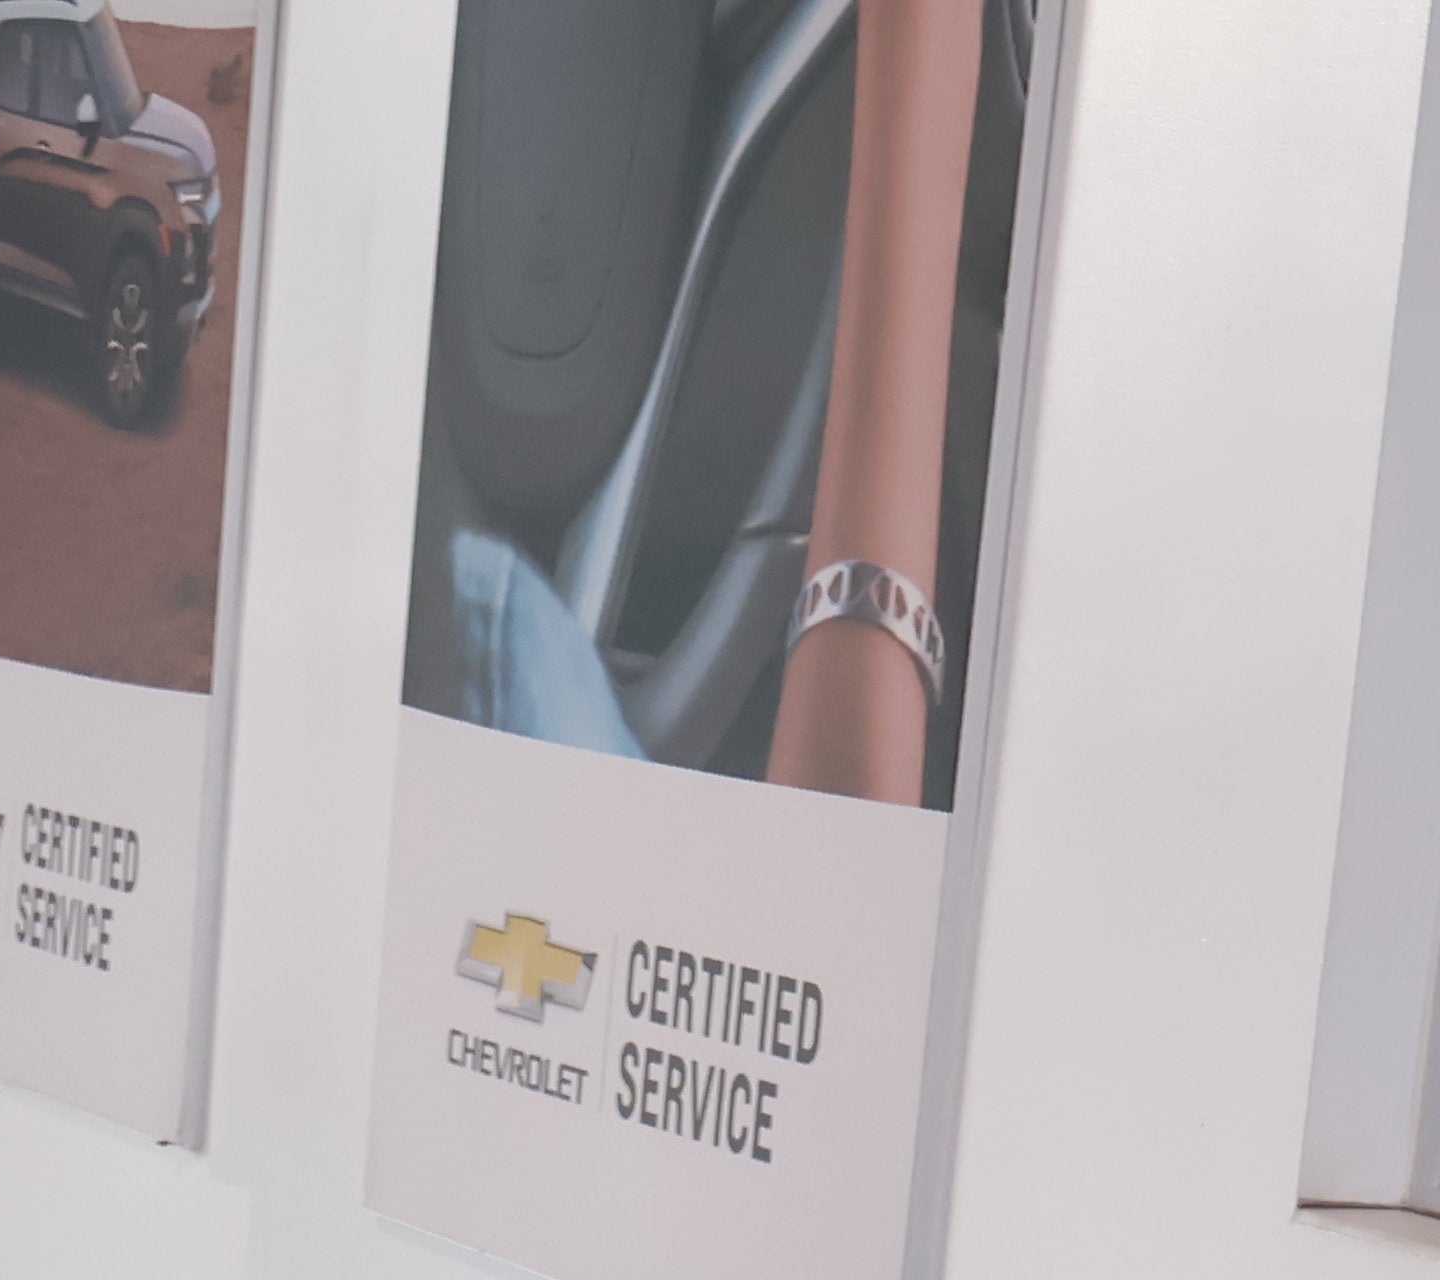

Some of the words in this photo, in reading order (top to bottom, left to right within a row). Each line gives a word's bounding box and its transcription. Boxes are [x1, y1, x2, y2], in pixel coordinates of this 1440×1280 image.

[21, 802, 140, 893] CERTIFIED
[15, 883, 114, 971] SERVICE
[624, 939, 824, 1065] CERTIFIED
[447, 1028, 589, 1104] CHEVROLET
[616, 1041, 778, 1163] SERVICE
